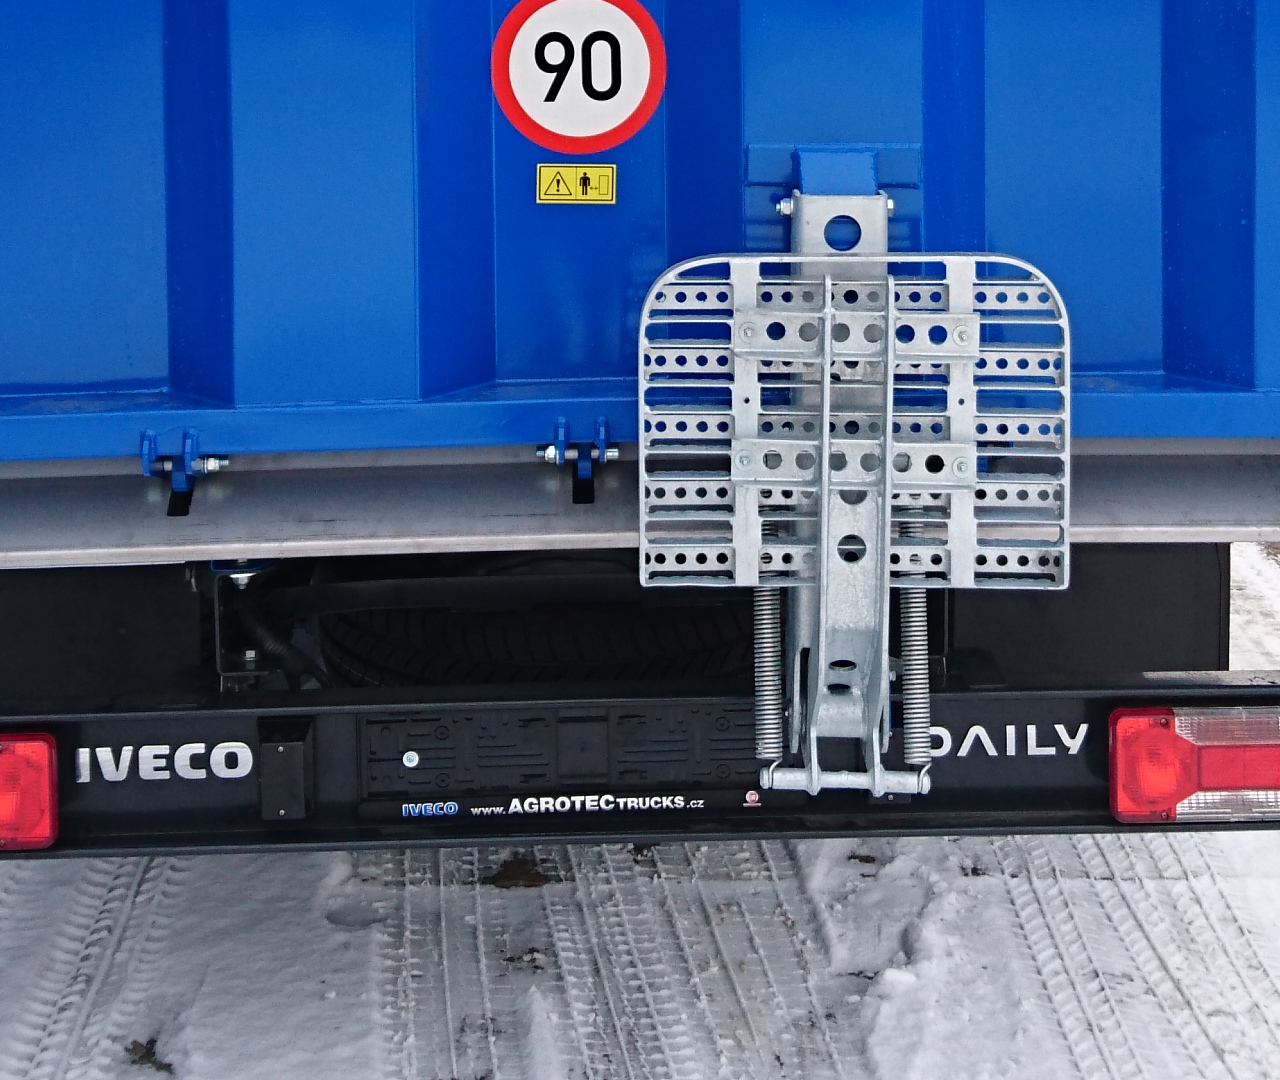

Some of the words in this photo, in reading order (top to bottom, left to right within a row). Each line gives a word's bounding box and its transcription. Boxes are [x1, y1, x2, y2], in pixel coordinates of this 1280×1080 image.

[534, 30, 622, 103] 90
[77, 741, 254, 784] IVECO
[402, 802, 458, 816] IVECO
[471, 794, 704, 816] www.AGROTECTRUCKS.cz
